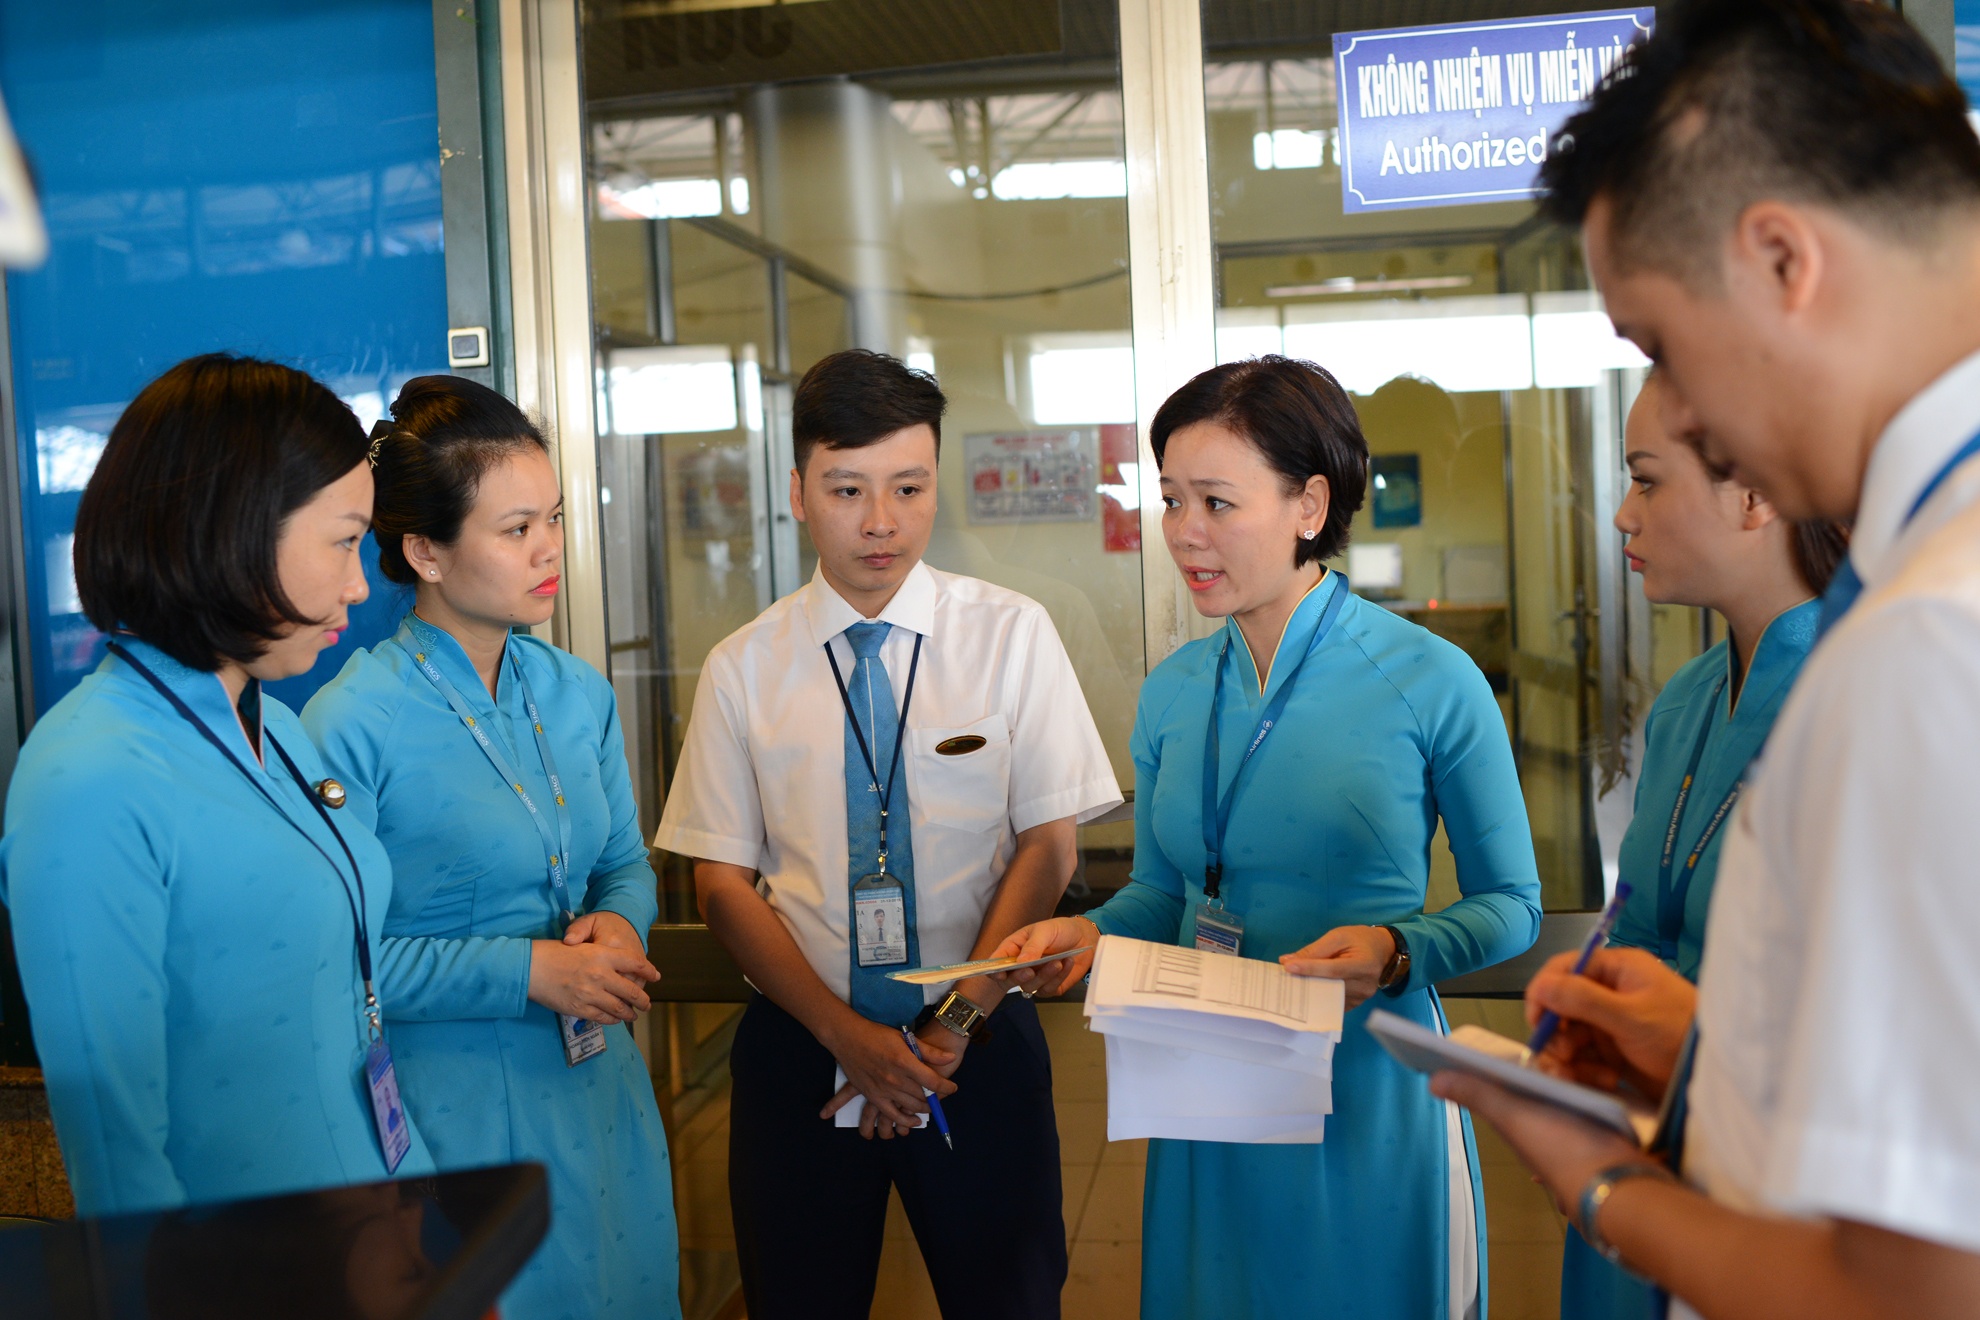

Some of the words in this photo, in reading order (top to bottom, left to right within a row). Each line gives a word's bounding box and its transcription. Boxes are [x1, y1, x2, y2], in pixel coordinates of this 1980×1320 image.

[1358, 53, 1429, 119] KHÔNG
[1433, 46, 1503, 119] NHIỆM
[1506, 52, 1535, 116] VỤ
[1539, 31, 1595, 104] MIỄN
[1380, 127, 1548, 177] Authorized
[423, 660, 441, 681] VIAGS
[529, 703, 540, 723] VIAGS
[473, 726, 489, 746] VIAGS
[522, 793, 537, 813] VIAGS
[553, 865, 564, 888] VIAGS
